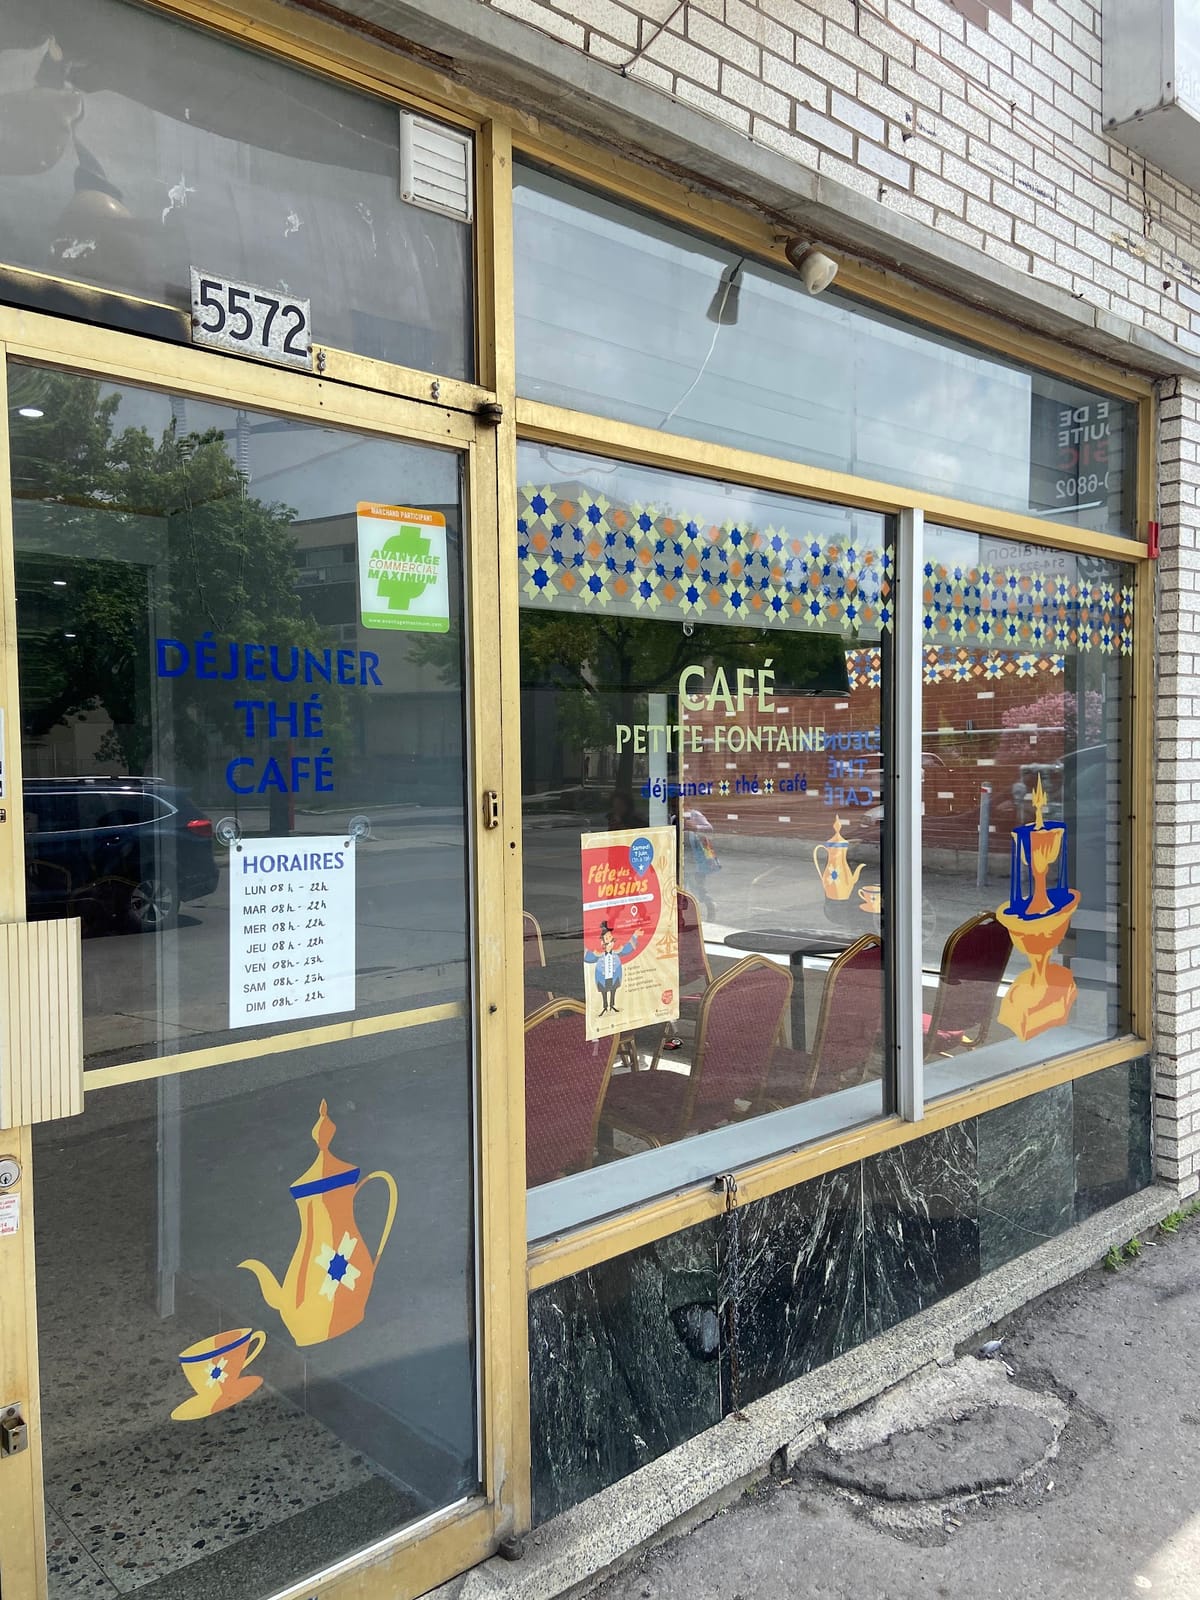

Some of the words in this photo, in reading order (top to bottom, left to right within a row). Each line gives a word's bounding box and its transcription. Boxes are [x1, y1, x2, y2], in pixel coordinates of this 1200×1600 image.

[201, 279, 307, 357] 5572
[370, 506, 400, 518] MARCHAND
[400, 510, 433, 522] PARTICIPANT
[370, 549, 440, 565] AVANTAGE
[368, 559, 439, 575] COMMERCIAL
[367, 568, 438, 584] MAXIMUM
[156, 632, 383, 686] DÉJEUNER
[679, 658, 775, 713] CAFÉ
[233, 693, 324, 738] THÉ
[616, 724, 703, 754] PETITE
[714, 725, 825, 753] FONTAINE
[226, 747, 334, 795] CAFÉ
[640, 777, 714, 803] déjeuner
[735, 775, 760, 794] thé
[779, 773, 808, 792] café
[243, 851, 344, 874] HORAIRES
[587, 863, 617, 885] Fête
[617, 867, 631, 877] des
[244, 885, 266, 895] LUN
[243, 904, 266, 915] MAR
[243, 925, 266, 935] MER
[246, 943, 266, 954] JEU
[244, 963, 266, 973] VEN
[243, 982, 266, 993] SAM
[246, 1001, 266, 1012] DIM
